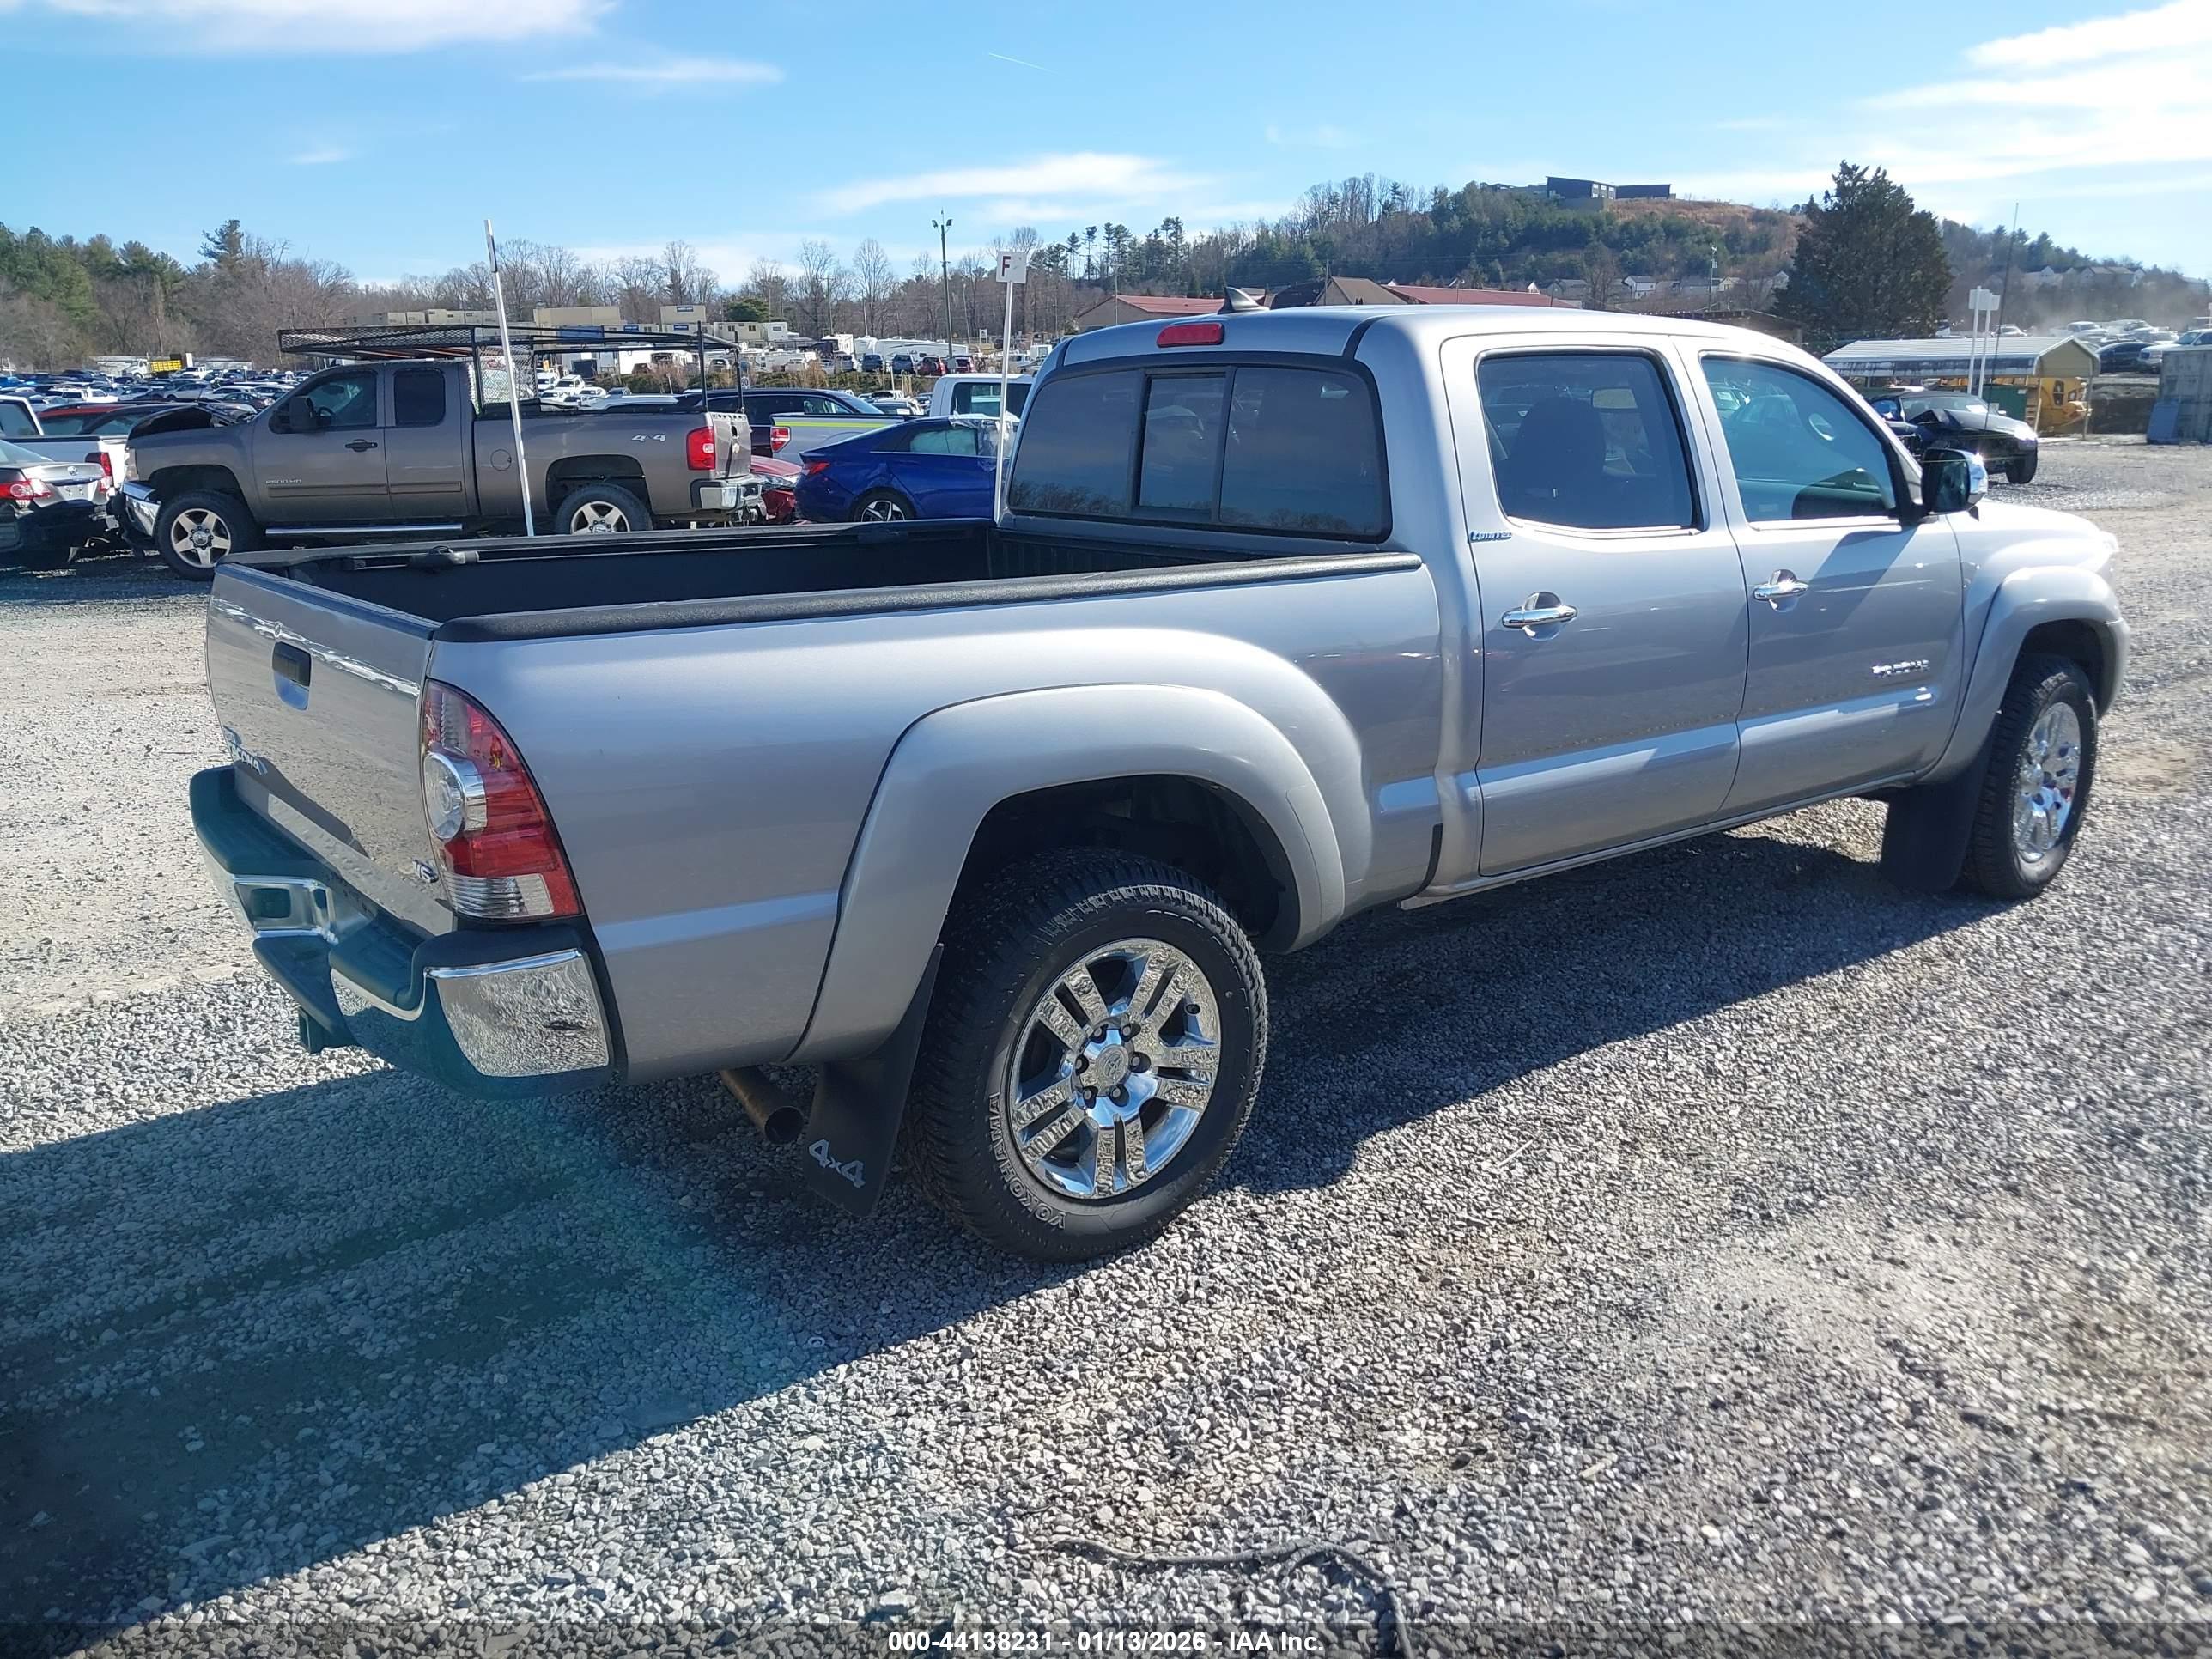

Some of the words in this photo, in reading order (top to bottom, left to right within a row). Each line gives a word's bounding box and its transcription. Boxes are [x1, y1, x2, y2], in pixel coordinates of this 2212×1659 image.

[1001, 255, 1012, 277] F
[808, 1139, 866, 1189] 4x4
[988, 1091, 1067, 1230] YOKOHAMA
